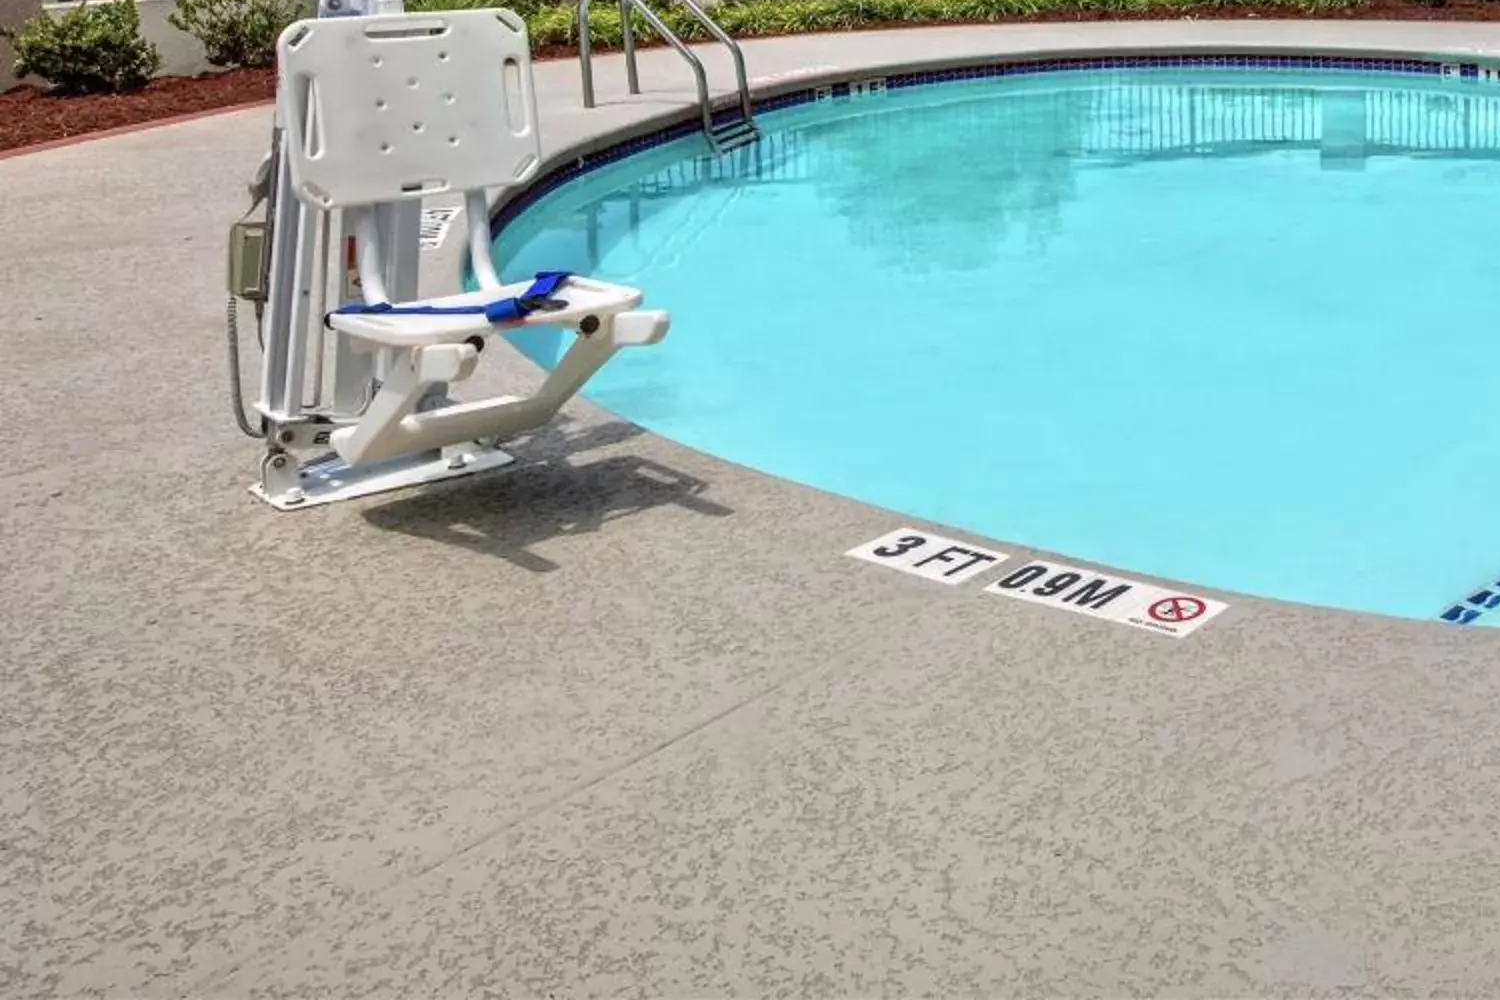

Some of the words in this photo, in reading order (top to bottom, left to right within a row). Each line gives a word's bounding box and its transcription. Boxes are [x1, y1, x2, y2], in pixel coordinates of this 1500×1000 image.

[873, 535, 927, 558] 3
[913, 548, 998, 577] FT
[998, 564, 1132, 609] 0.9M
